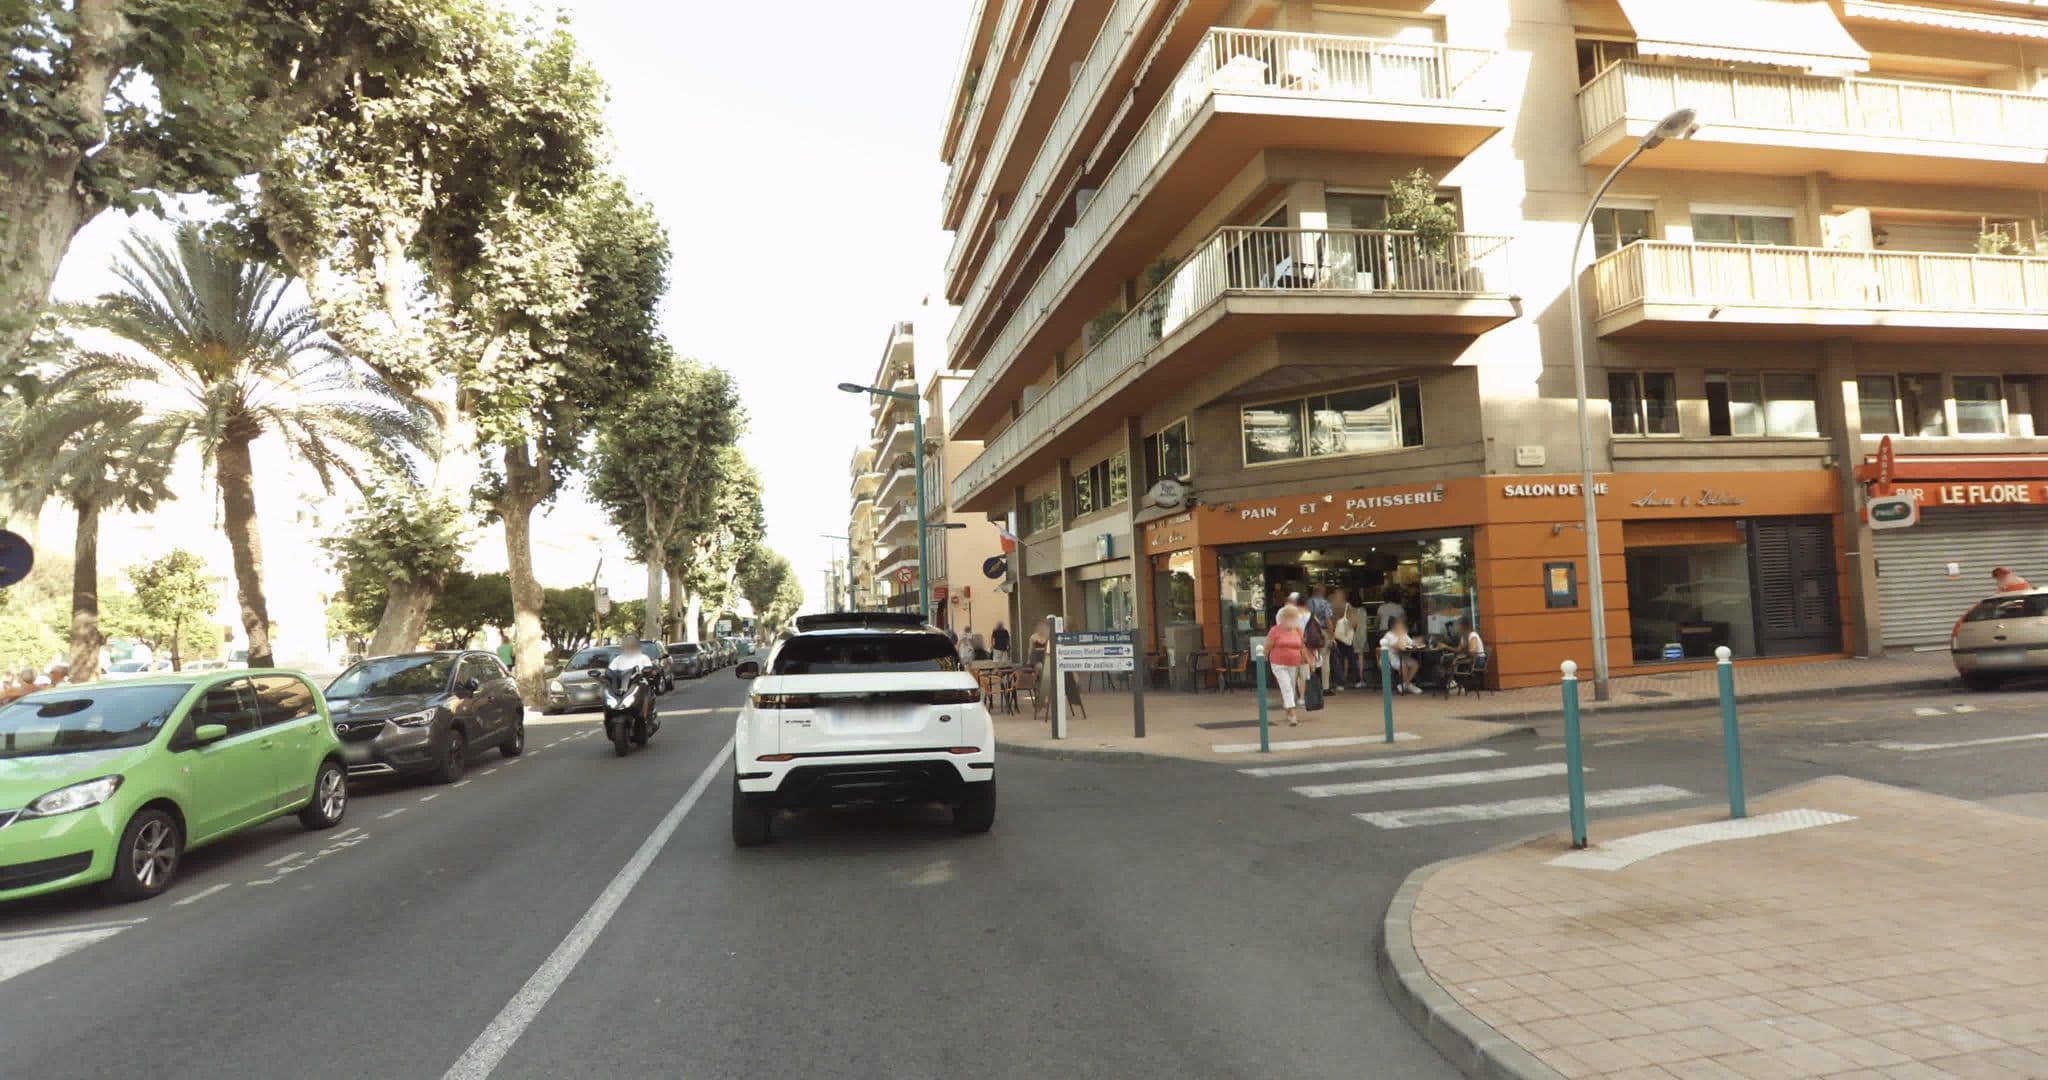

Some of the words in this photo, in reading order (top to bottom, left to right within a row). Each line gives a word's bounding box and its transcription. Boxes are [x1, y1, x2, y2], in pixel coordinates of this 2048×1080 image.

[1504, 484, 1555, 497] SALON
[1558, 483, 1577, 496] DE
[1940, 486, 1966, 504] LE
[1968, 484, 2031, 504] FLORE
[1241, 506, 1277, 521] PAIN
[1299, 502, 1316, 515] ET
[1345, 491, 1444, 511] PATISSERIE
